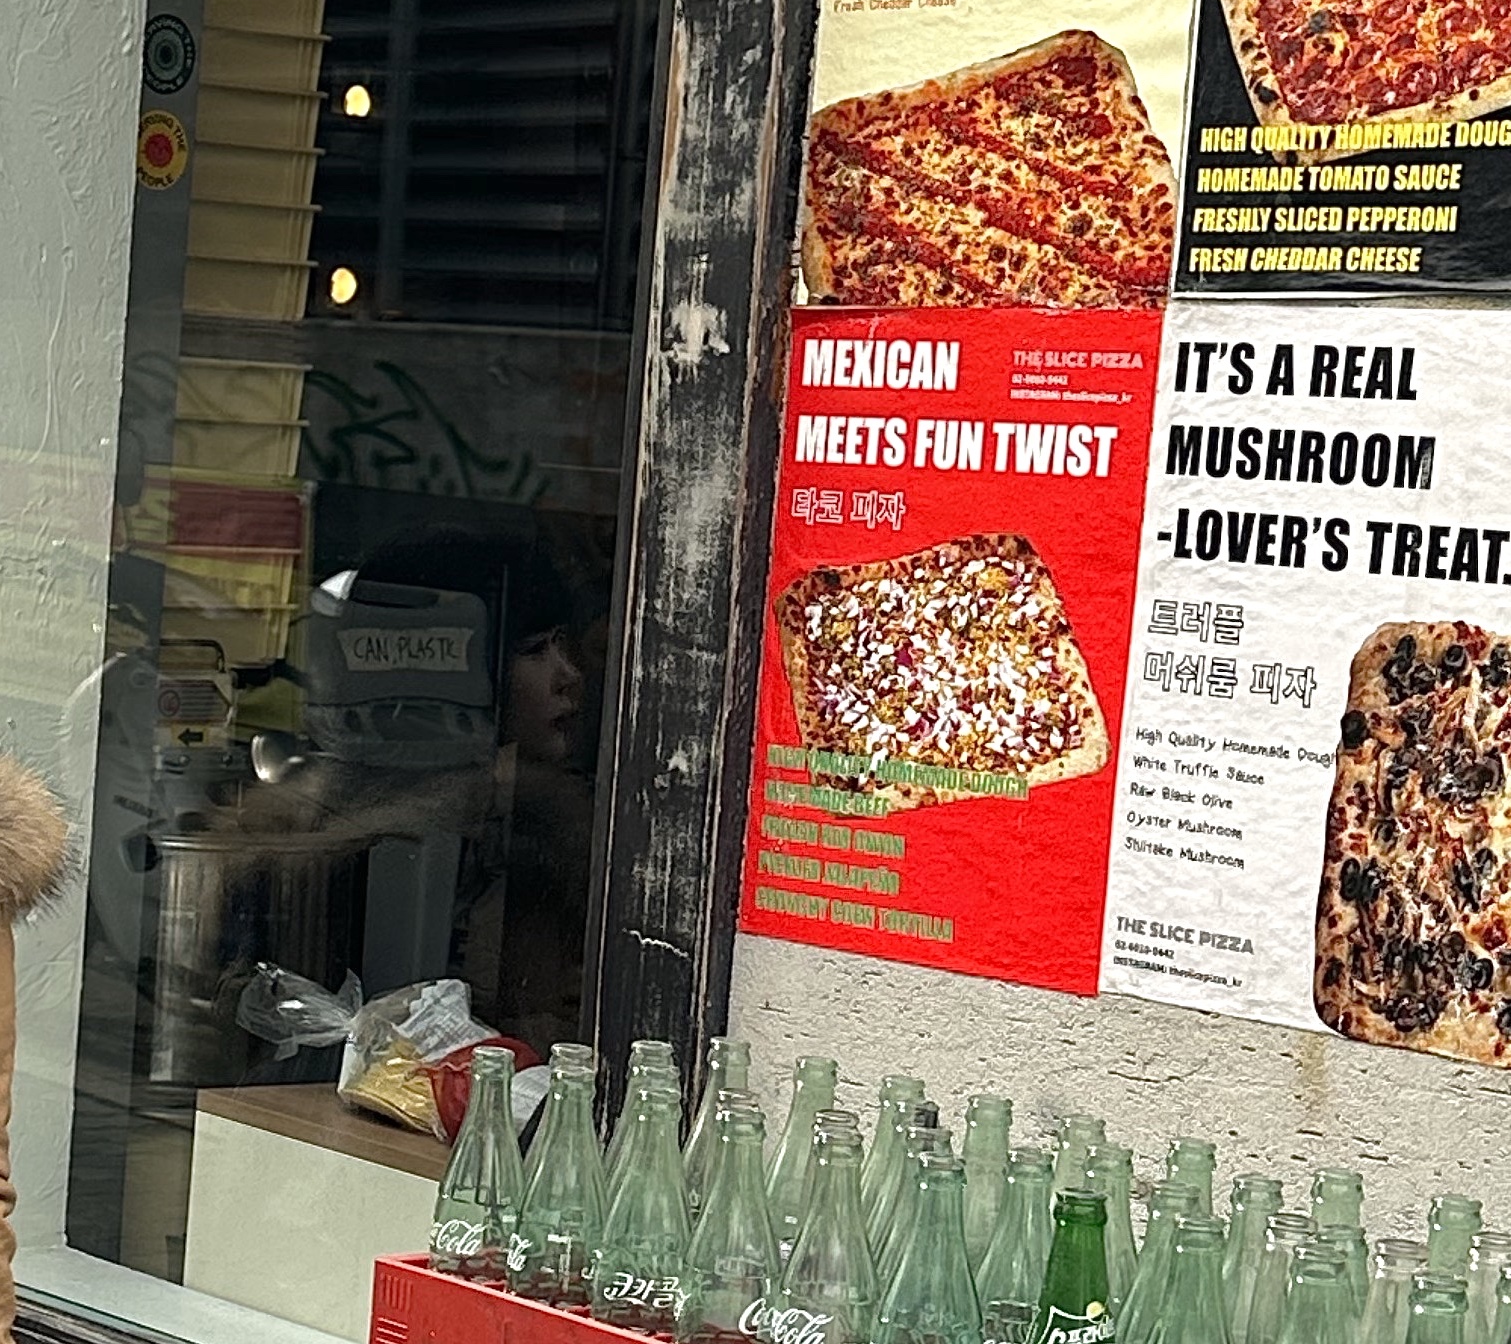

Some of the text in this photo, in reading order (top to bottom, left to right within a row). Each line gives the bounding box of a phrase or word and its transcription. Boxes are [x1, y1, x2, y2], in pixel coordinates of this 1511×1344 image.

[1200, 127, 1247, 152] HIGH
[1250, 124, 1332, 154] QUALITY
[1334, 121, 1450, 151] HOMEMADE
[1196, 163, 1463, 193] HOMEMADE TOMATO SAUCE
[1192, 205, 1458, 233] FRESHLY SLICED PEPPERONI
[1188, 246, 1422, 273] FRESH CHEDDAR CHEESE
[801, 338, 961, 392] MEXICAN
[1013, 350, 1143, 369] THE SLICE PIZZA
[1174, 341, 1255, 395] IT'S
[1266, 344, 1294, 396] A
[1308, 345, 1417, 400] REAL
[794, 414, 1119, 479] MEETS FUN TWIST
[1165, 425, 1436, 490] MUSHROOM
[791, 487, 907, 532] 타코 피자
[1157, 508, 1350, 571] -LOVER'S
[1148, 599, 1244, 645] 트러플
[1143, 652, 1317, 709] 머쉬룸 피자
[1136, 726, 1290, 760] High Quality Homemade
[1174, 759, 1219, 779] Truffle
[1117, 916, 1147, 935] THE
[1149, 921, 1195, 944] SLICE
[1199, 930, 1254, 955] PIZZA
